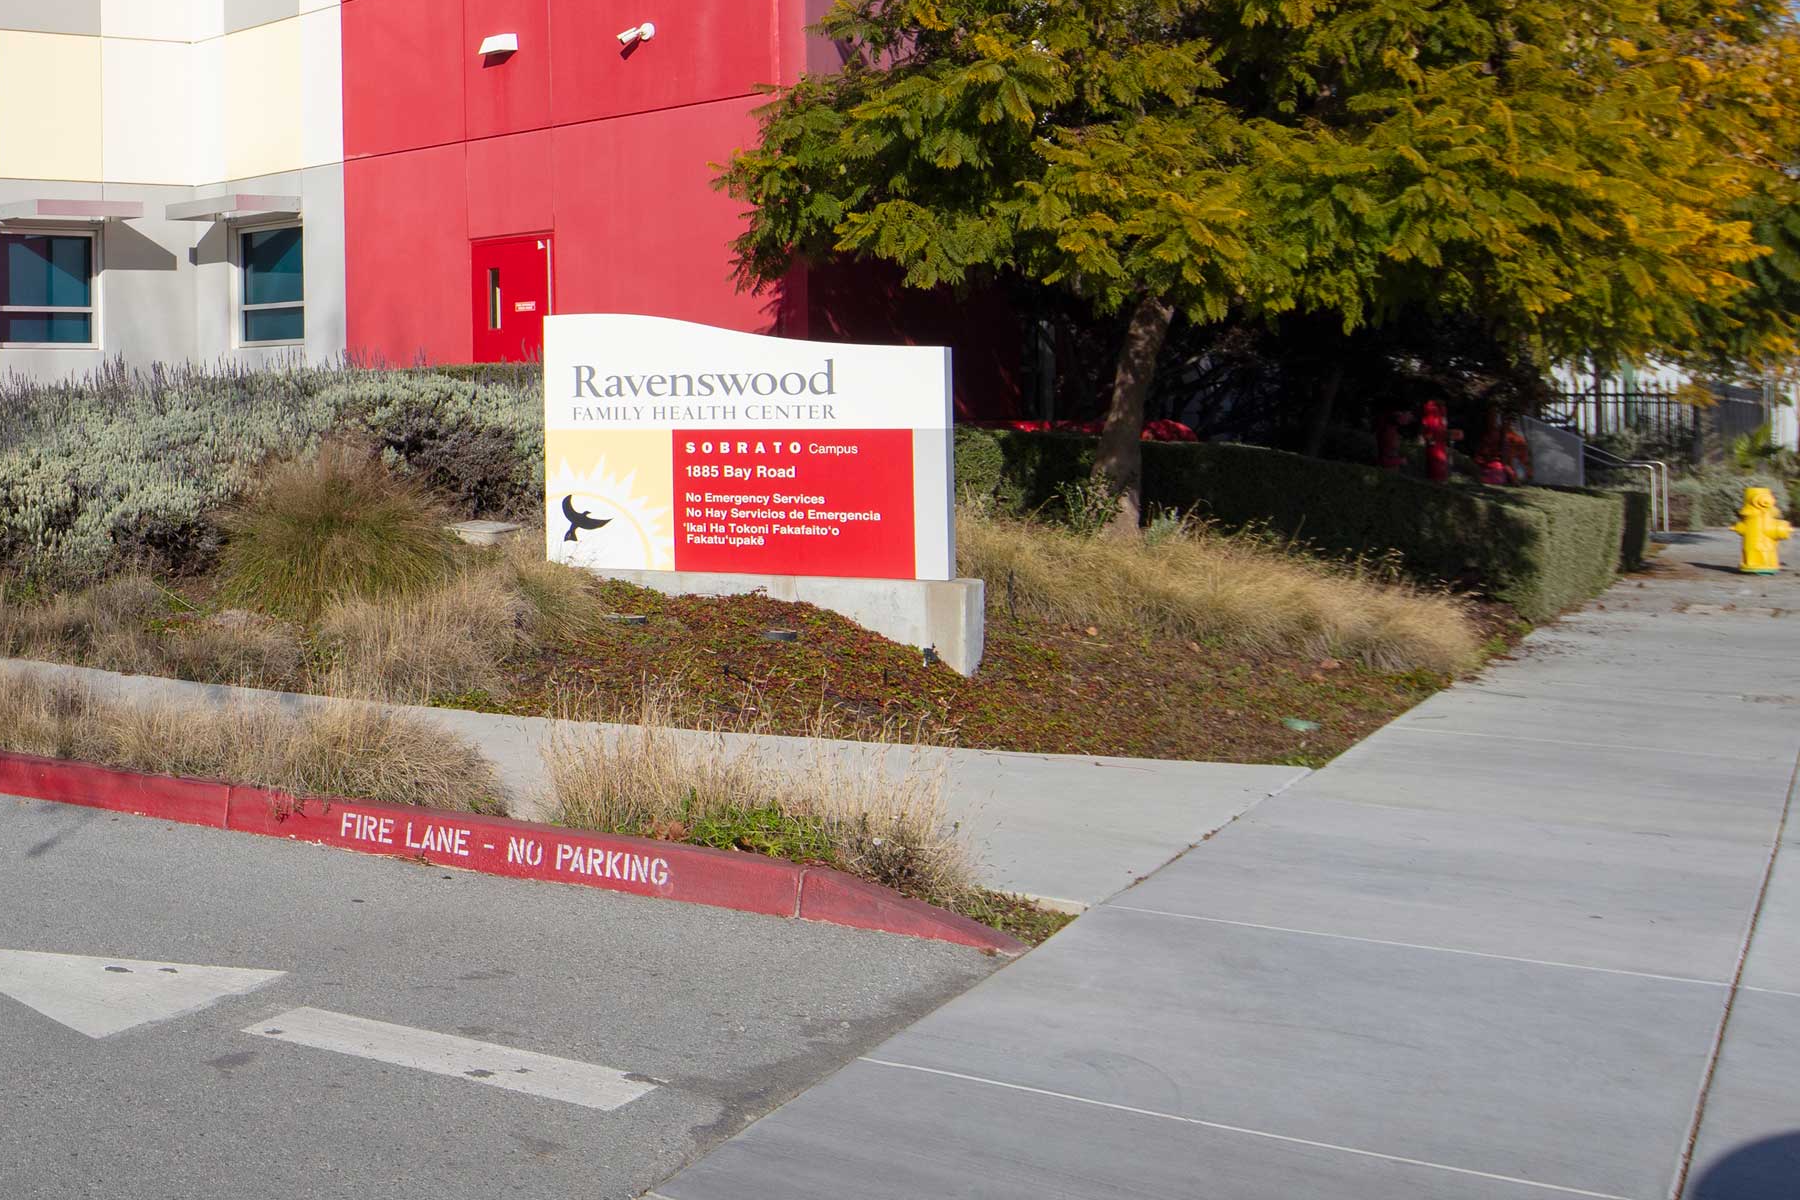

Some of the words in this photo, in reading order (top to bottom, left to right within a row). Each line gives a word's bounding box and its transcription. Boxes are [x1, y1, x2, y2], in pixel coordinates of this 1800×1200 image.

[571, 358, 838, 398] Ravenswood
[572, 406, 644, 421] FAMILY
[652, 405, 737, 421] HEALTH
[745, 404, 837, 420] CENTER
[685, 442, 802, 454] SOBRATO
[808, 443, 859, 457] Campus
[685, 465, 719, 478] 1885
[723, 466, 752, 481] Bay
[756, 465, 797, 478] Road
[685, 492, 702, 503] No
[704, 494, 770, 506] Emergency
[772, 494, 826, 505] Services
[686, 508, 702, 518] No
[704, 508, 728, 521] Hay
[730, 508, 787, 520] Servicios
[788, 508, 805, 520] de
[807, 510, 882, 523] Emergencia
[709, 524, 726, 534] Ha
[728, 524, 770, 535] Tokoni
[340, 812, 394, 844] FIRE
[406, 822, 471, 856] LANE
[508, 836, 543, 866] NO
[555, 843, 669, 886] PARKING
